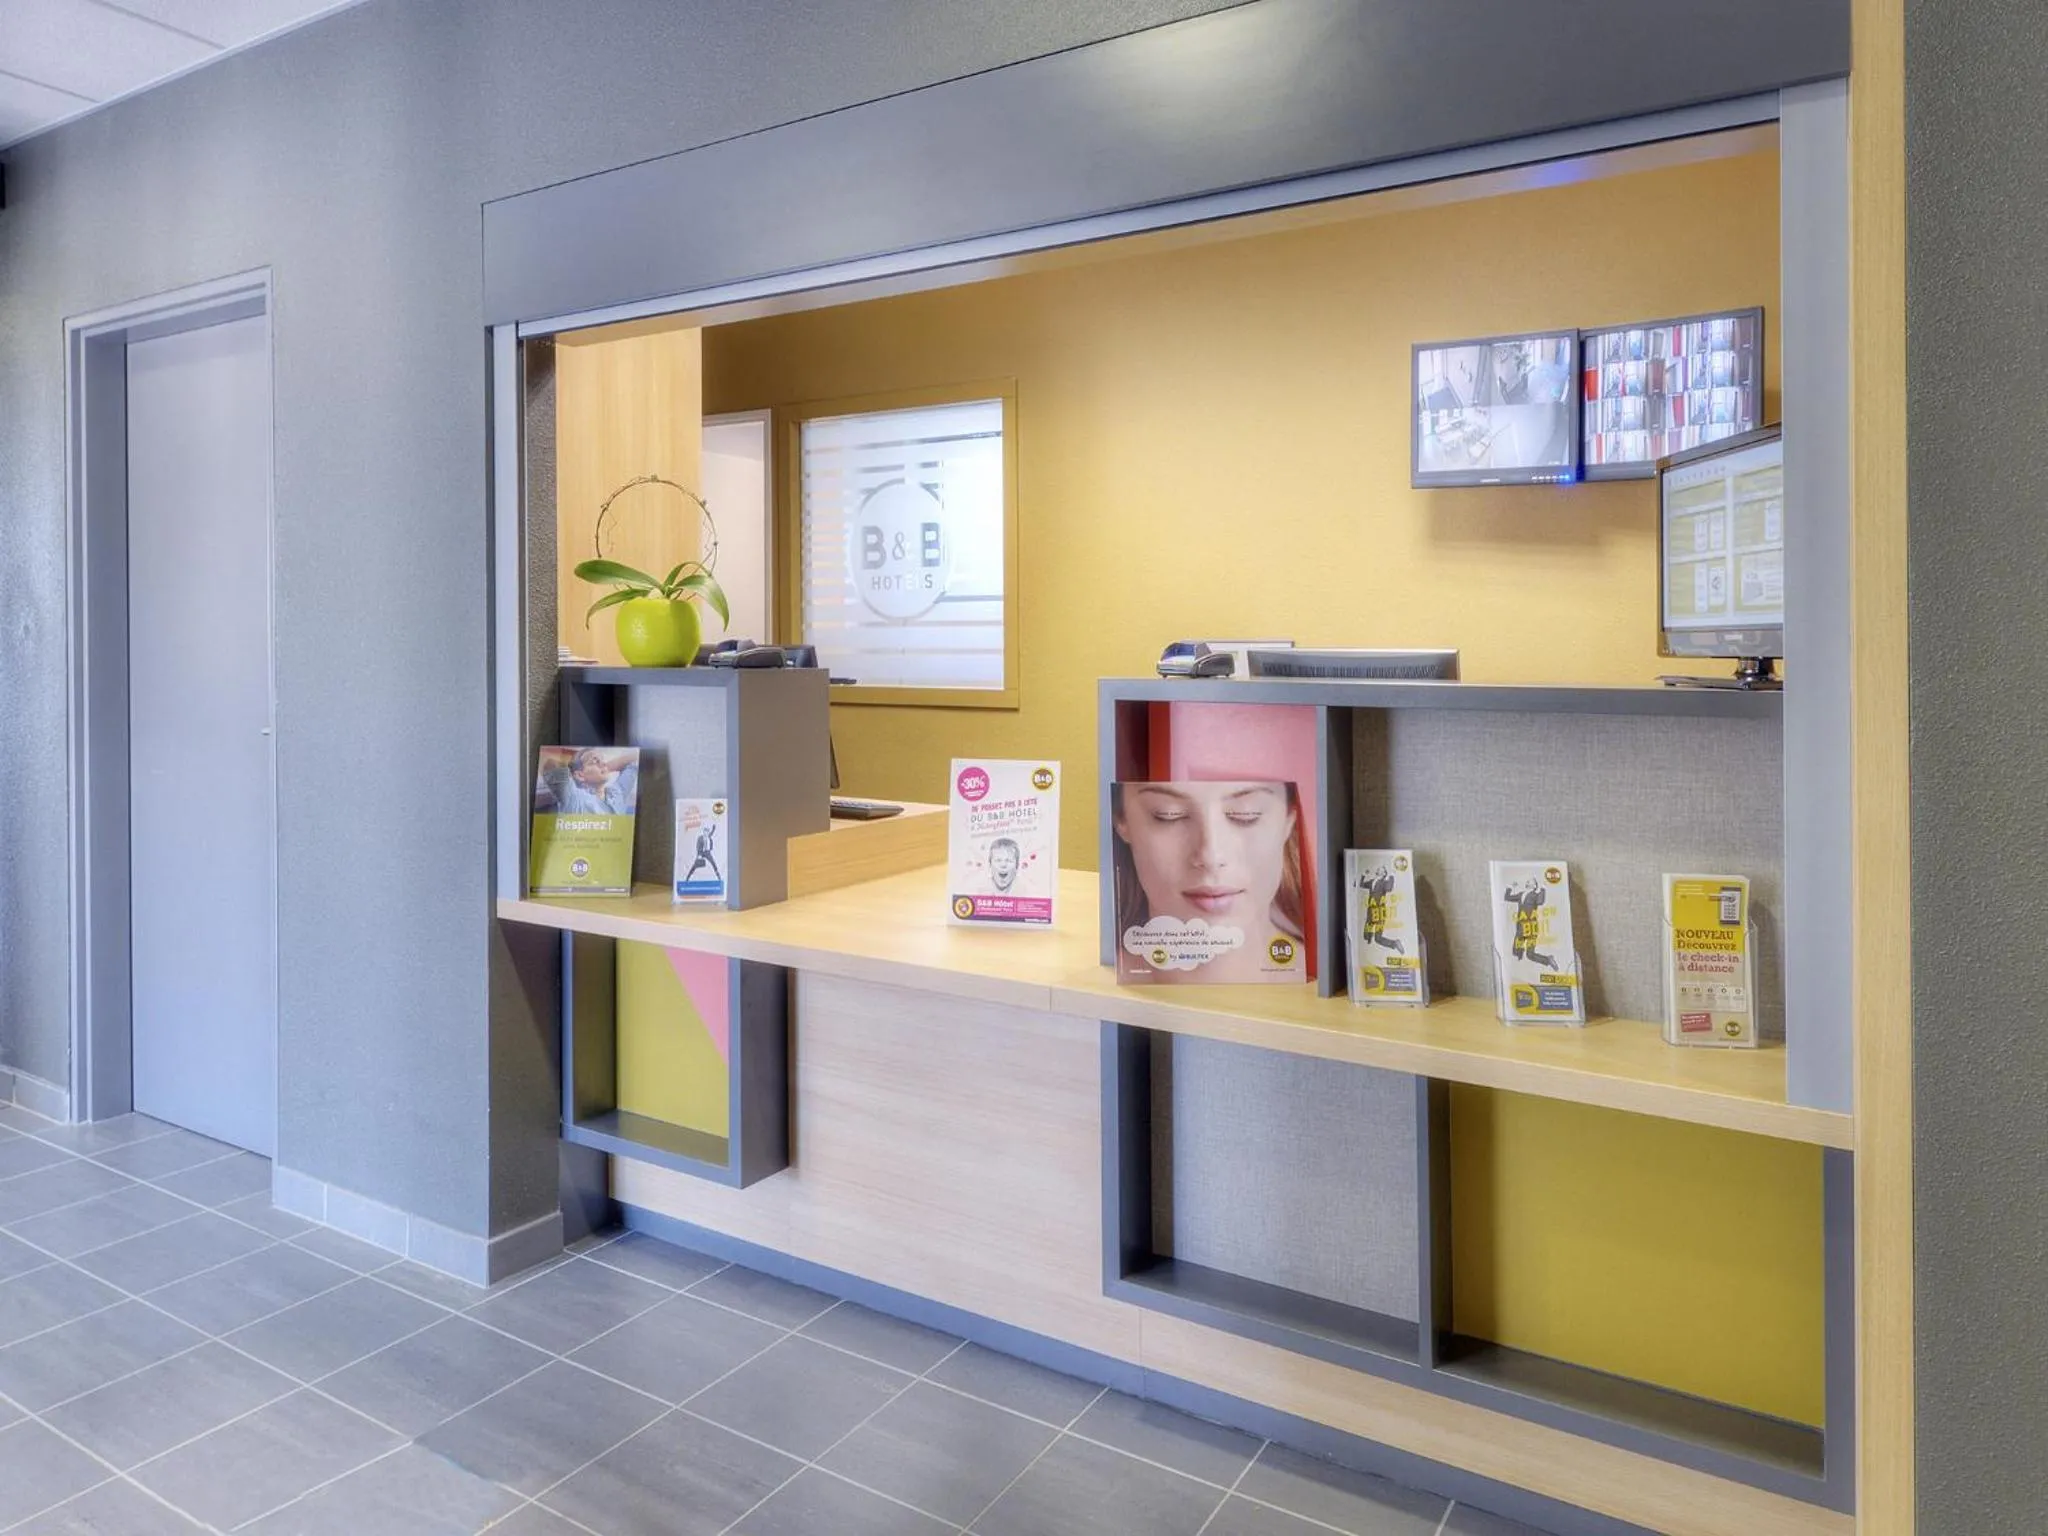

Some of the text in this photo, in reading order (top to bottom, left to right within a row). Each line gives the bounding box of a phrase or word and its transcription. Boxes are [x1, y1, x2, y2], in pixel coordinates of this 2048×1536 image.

[961, 775, 986, 790] -30%
[971, 814, 983, 823] DU
[1676, 928, 1735, 941] NOUVEAU
[1272, 945, 1292, 956] B&B
[1678, 951, 1740, 963] le check-in
[1687, 962, 1736, 974] distance
